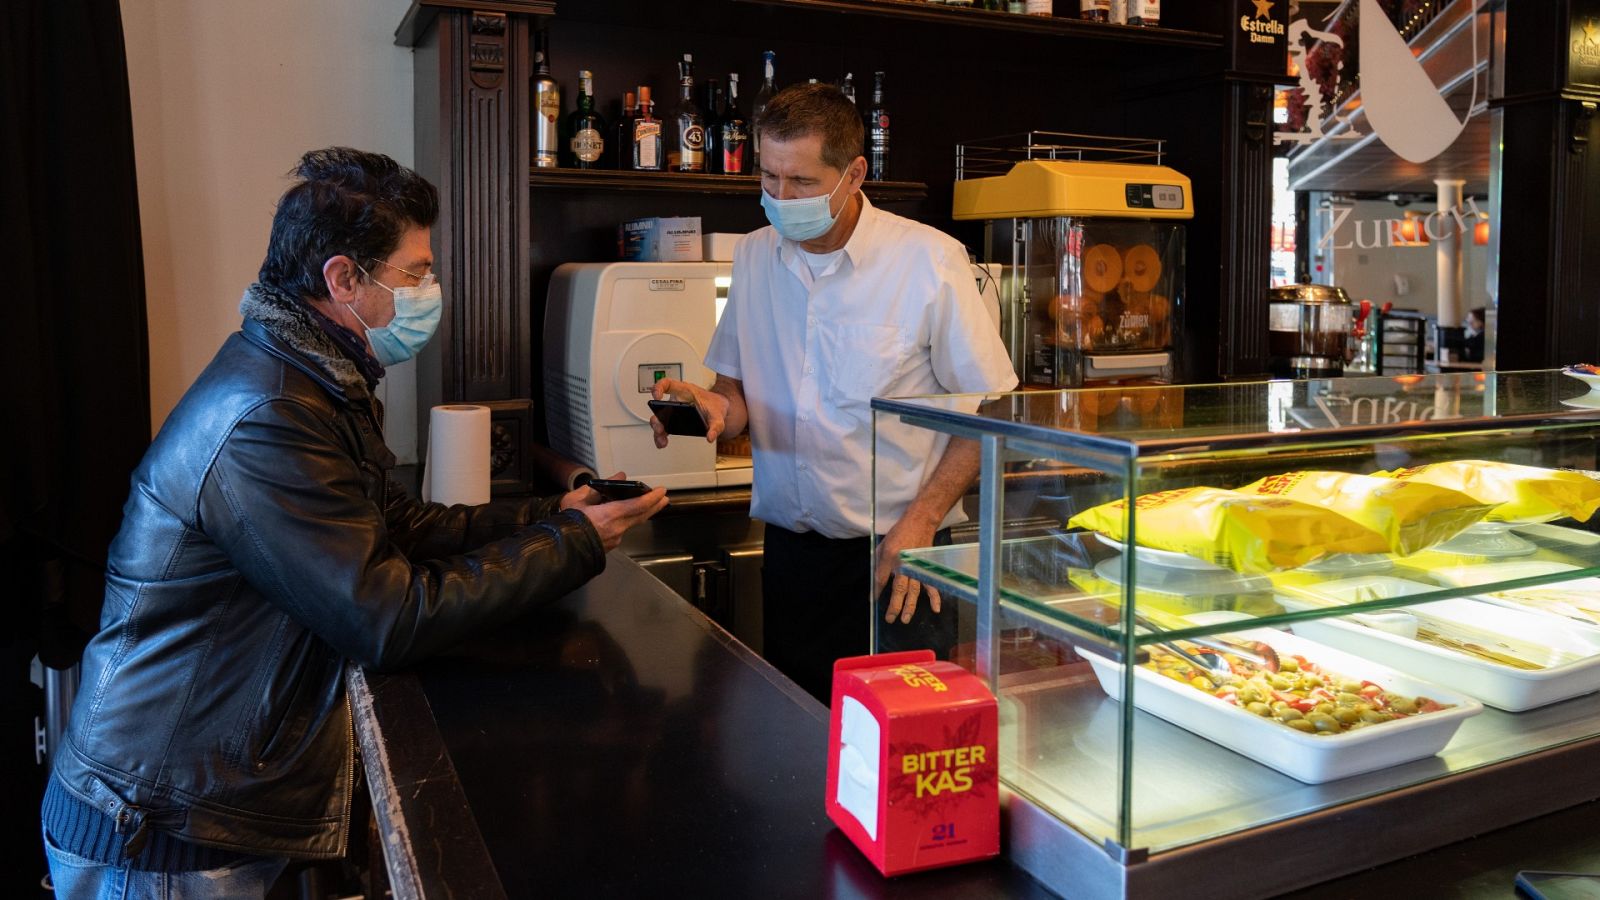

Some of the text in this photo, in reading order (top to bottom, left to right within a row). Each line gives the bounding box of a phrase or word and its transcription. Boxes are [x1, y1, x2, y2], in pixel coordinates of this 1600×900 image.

[1240, 15, 1284, 35] Estrella
[1250, 32, 1275, 44] Damm
[688, 131, 702, 143] 43
[902, 745, 986, 775] BITTER
[915, 766, 974, 799] KAS
